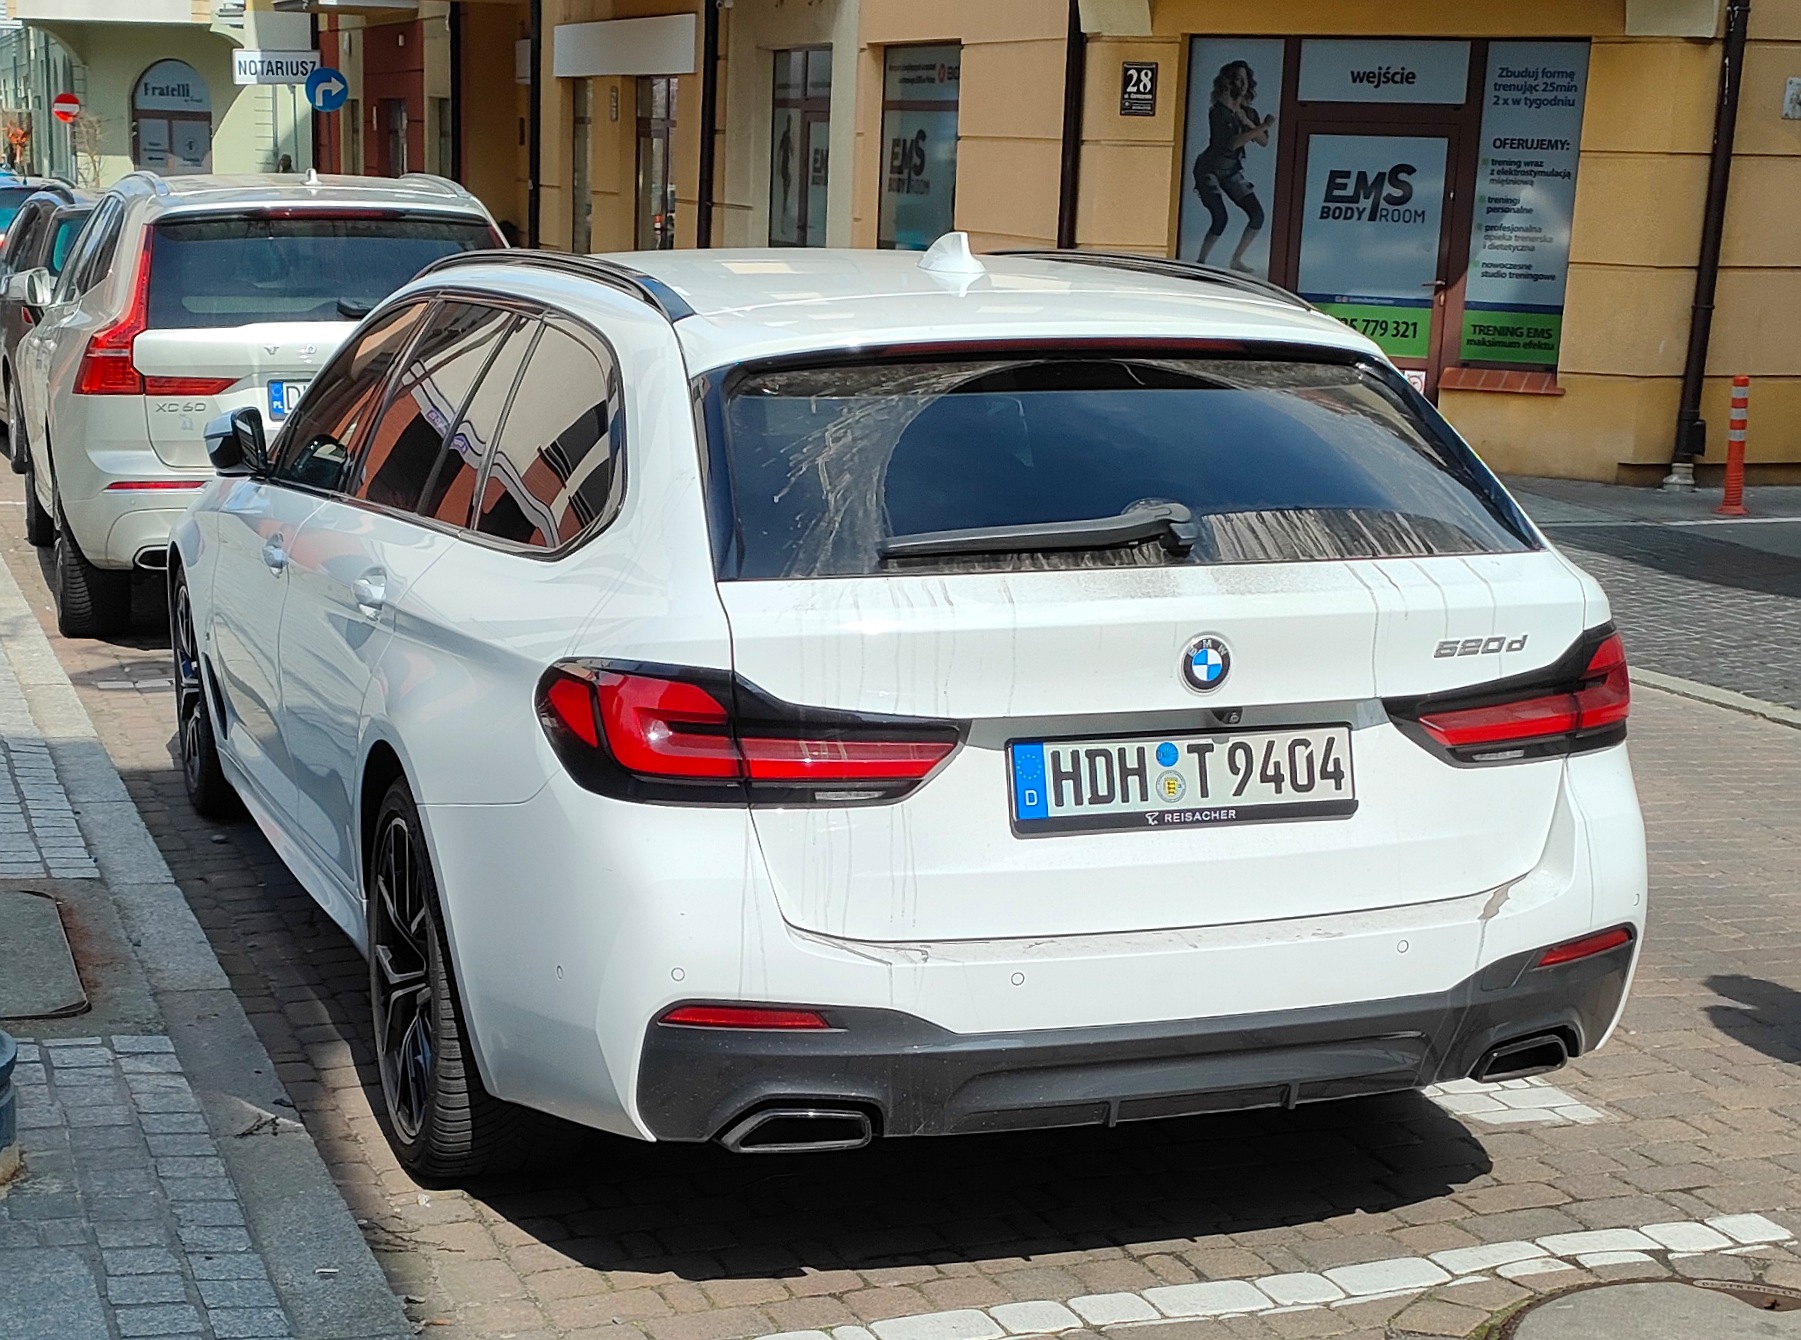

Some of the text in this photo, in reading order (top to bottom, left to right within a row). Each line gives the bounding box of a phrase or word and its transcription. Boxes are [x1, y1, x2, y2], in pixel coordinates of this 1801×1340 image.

[1126, 69, 1152, 92] 28
[1350, 66, 1416, 88] wejście
[1498, 67, 1575, 81] Zbuduj formę
[144, 82, 190, 97] Fratelli
[1494, 82, 1578, 94] trenując 25min
[1492, 95, 1575, 109] 2 x w tygodniu
[1493, 137, 1570, 151] OFERUJEMY:
[890, 129, 926, 193] EMS
[1491, 158, 1544, 169] trening wraz
[1496, 168, 1571, 180] elektrostymulacją
[1324, 163, 1417, 221] EMS
[1319, 206, 1425, 224] BODY ROOM
[1486, 206, 1534, 215] personalne
[1485, 224, 1542, 234] profesjonalna
[1481, 262, 1533, 271] nowoczesne
[1481, 270, 1556, 282] studio treningowe
[1361, 318, 1388, 337] 779
[1391, 320, 1418, 339] 321
[1471, 324, 1553, 339] TRENING EMS
[1466, 338, 1555, 351] maksimum efektu
[273, 401, 283, 409] PL
[1050, 746, 1149, 807] HDH
[1187, 743, 1214, 799] T
[1228, 736, 1345, 797] 9404
[1025, 789, 1039, 806] D
[1164, 809, 1236, 823] REISACHER
